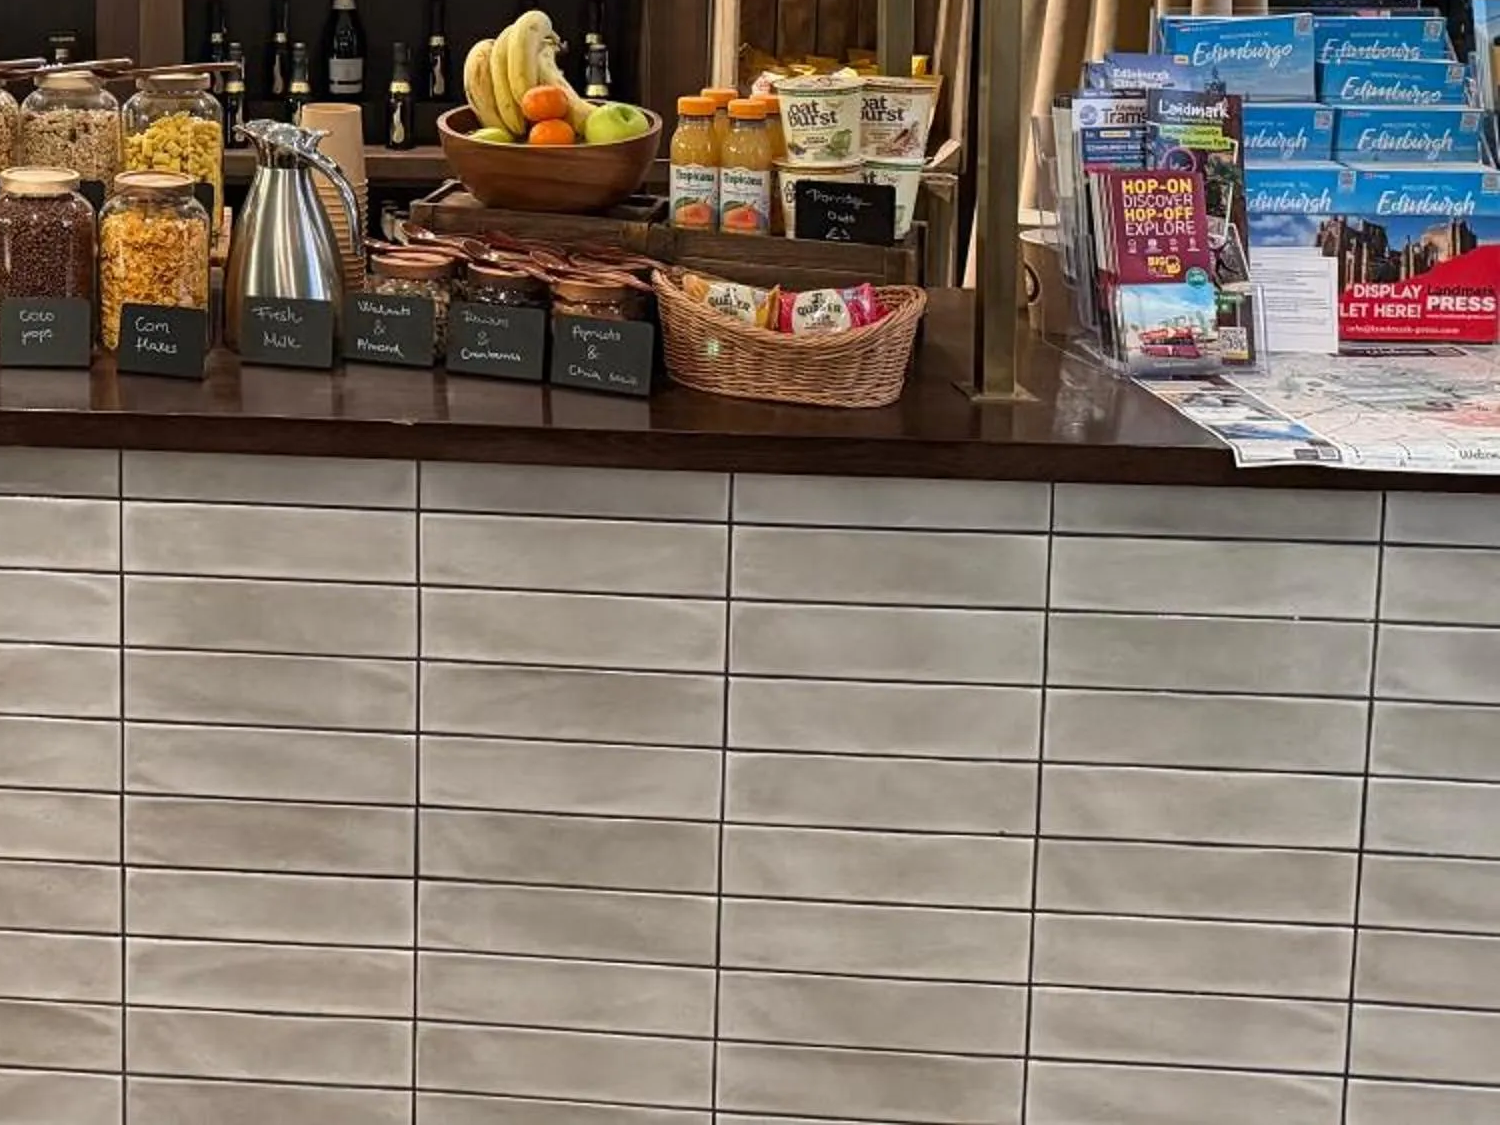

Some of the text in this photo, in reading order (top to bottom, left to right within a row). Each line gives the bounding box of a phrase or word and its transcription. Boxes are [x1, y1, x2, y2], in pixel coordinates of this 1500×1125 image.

[788, 99, 820, 115] oat
[788, 109, 839, 127] burst
[1357, 127, 1453, 159] Edinburgh
[675, 168, 715, 181] Tropicana
[722, 170, 763, 185] Tropicana
[1121, 178, 1193, 194] HOP-ON
[1123, 194, 1193, 208] DISCOVER
[1376, 189, 1476, 216] Edinburgh
[1124, 206, 1195, 222] HOP-OFF
[1125, 220, 1197, 236] EXPLORE
[1353, 284, 1422, 299] DISPLAY
[1373, 303, 1422, 318] HERE!
[1426, 296, 1497, 313] PRESS
